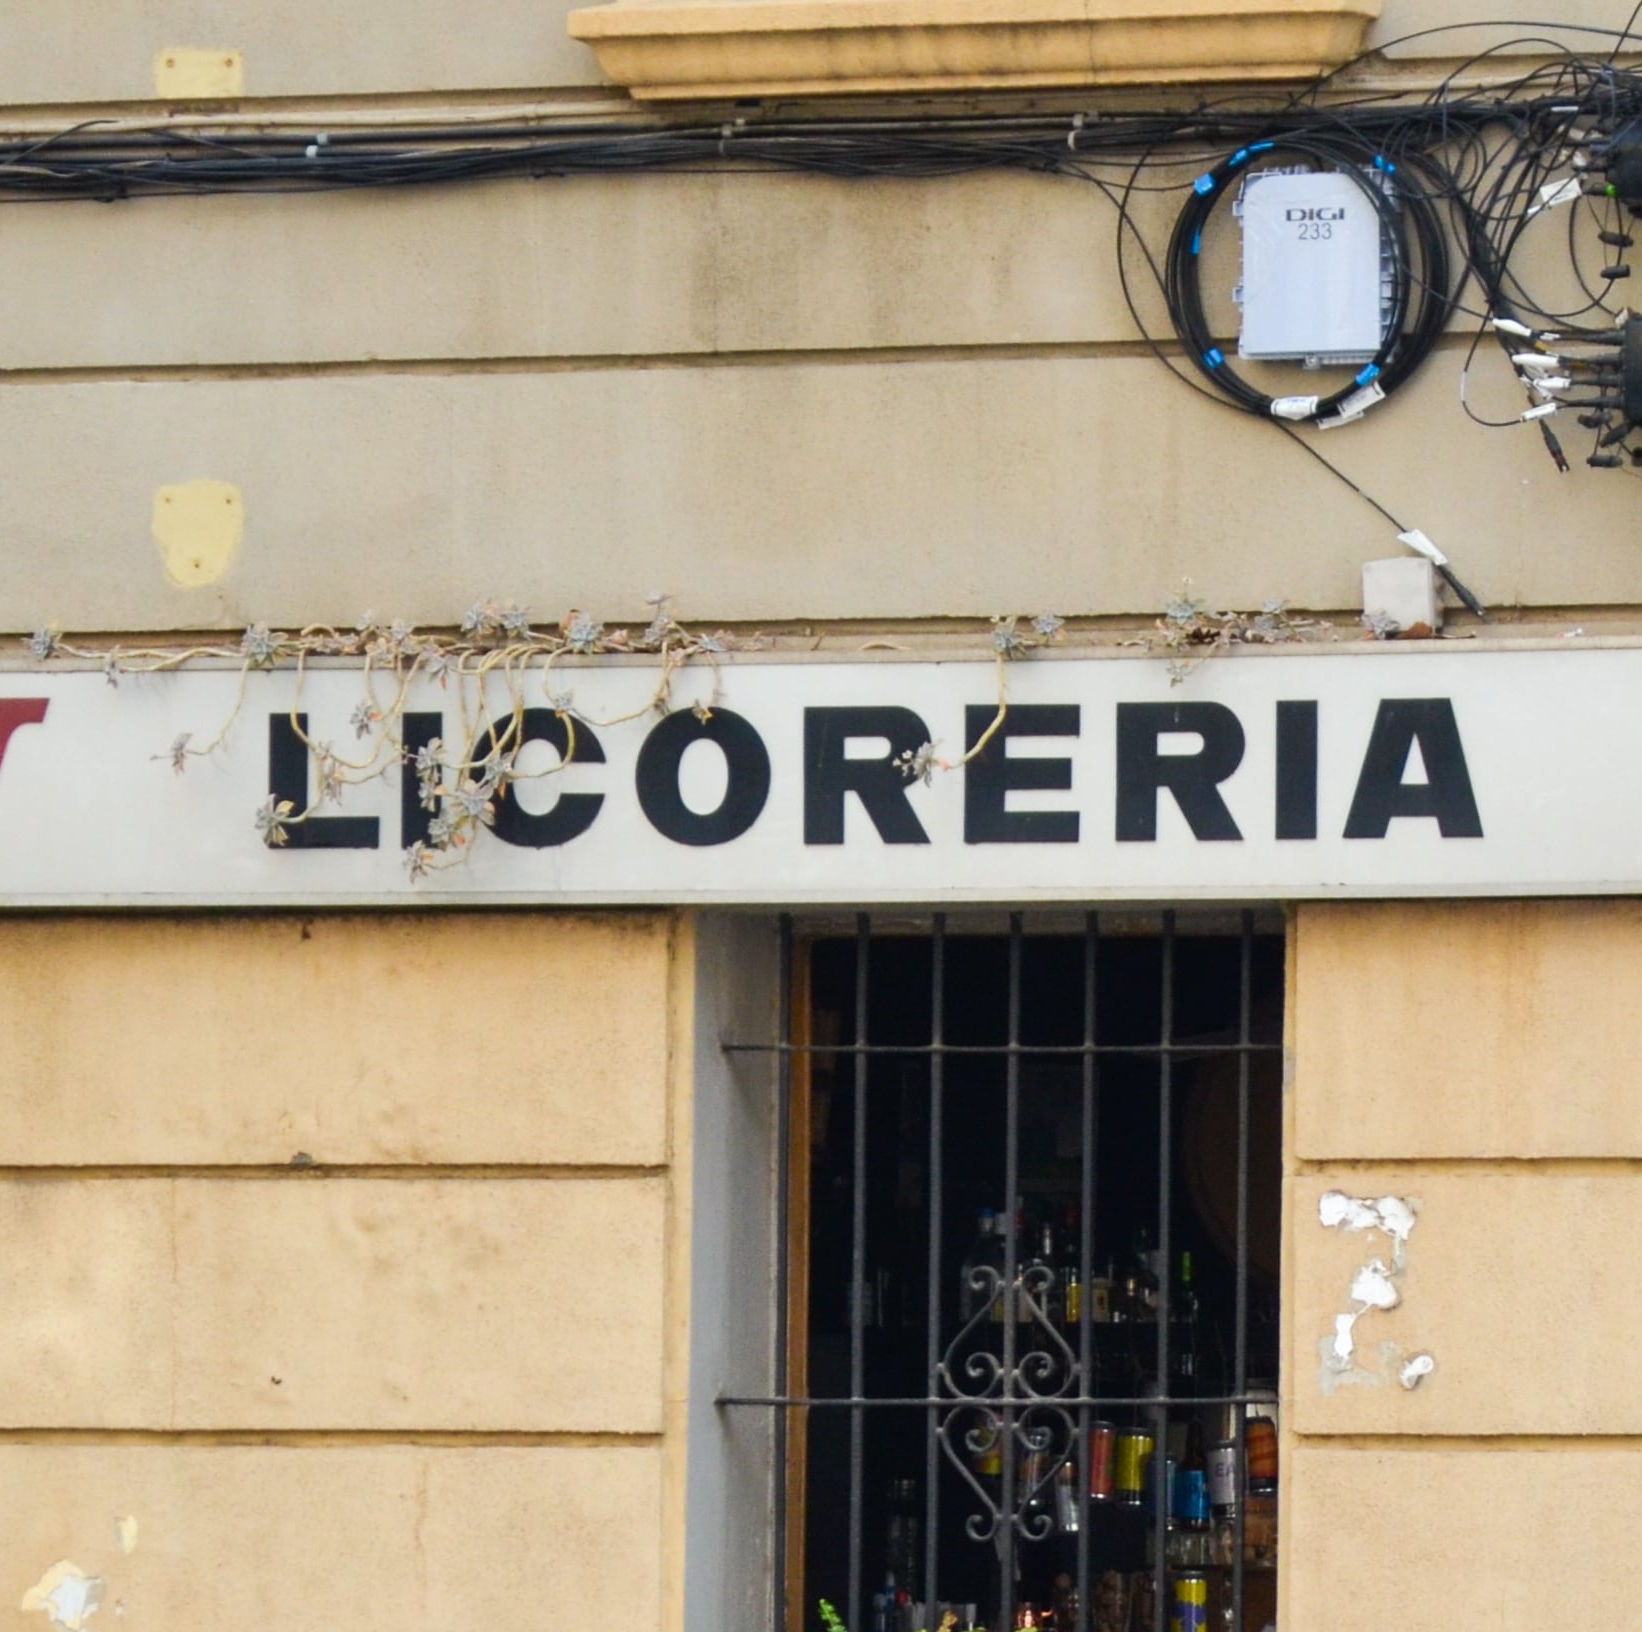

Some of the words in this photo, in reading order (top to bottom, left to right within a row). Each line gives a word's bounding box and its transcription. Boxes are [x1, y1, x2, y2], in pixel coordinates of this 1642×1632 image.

[1285, 207, 1345, 221] DIGI
[1297, 222, 1333, 240] 233
[268, 697, 1484, 850] LICORERIA
